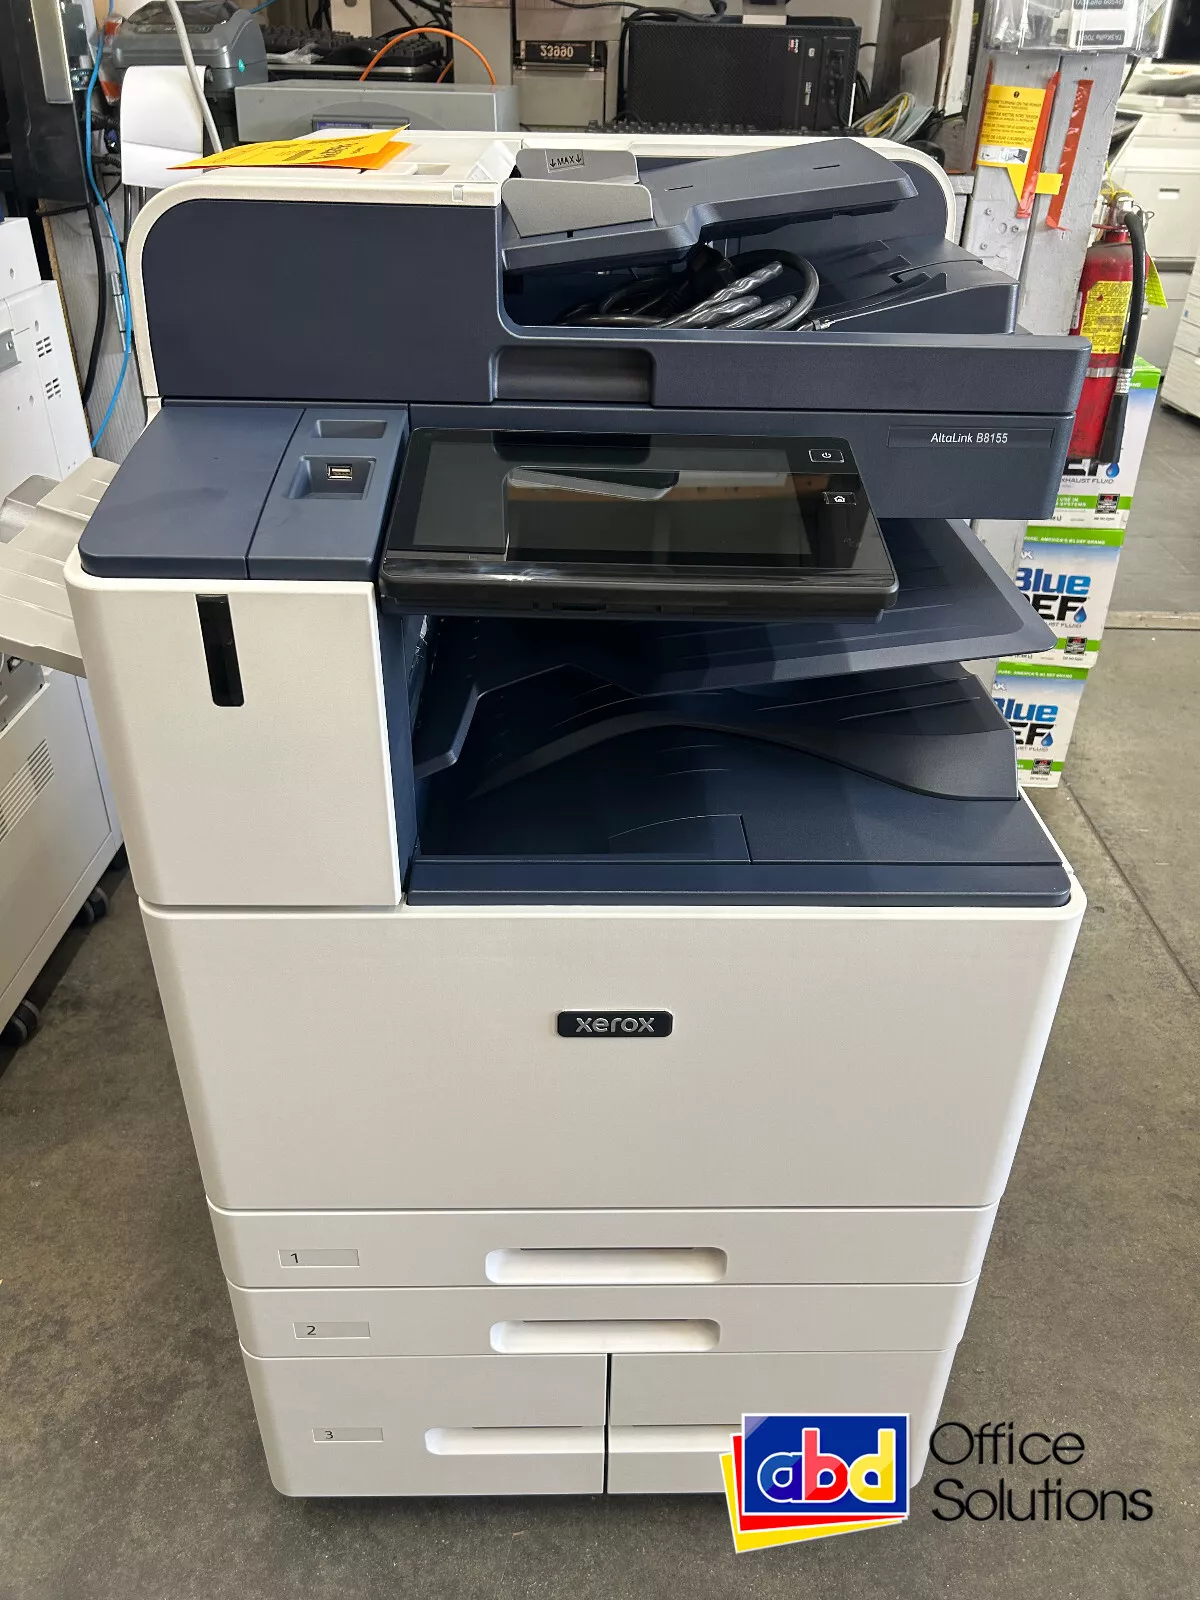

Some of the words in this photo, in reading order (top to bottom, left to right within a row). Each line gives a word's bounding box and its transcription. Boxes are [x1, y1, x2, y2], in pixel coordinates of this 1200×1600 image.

[556, 155, 575, 166] MAX
[930, 432, 973, 443] AltaLink
[976, 432, 1009, 444] B8155
[1015, 567, 1092, 596] Blue
[1008, 721, 1055, 746] EF
[575, 1017, 655, 1033] xerox
[290, 1252, 299, 1264] 1
[306, 1325, 317, 1336] 2
[324, 1430, 334, 1440] 3
